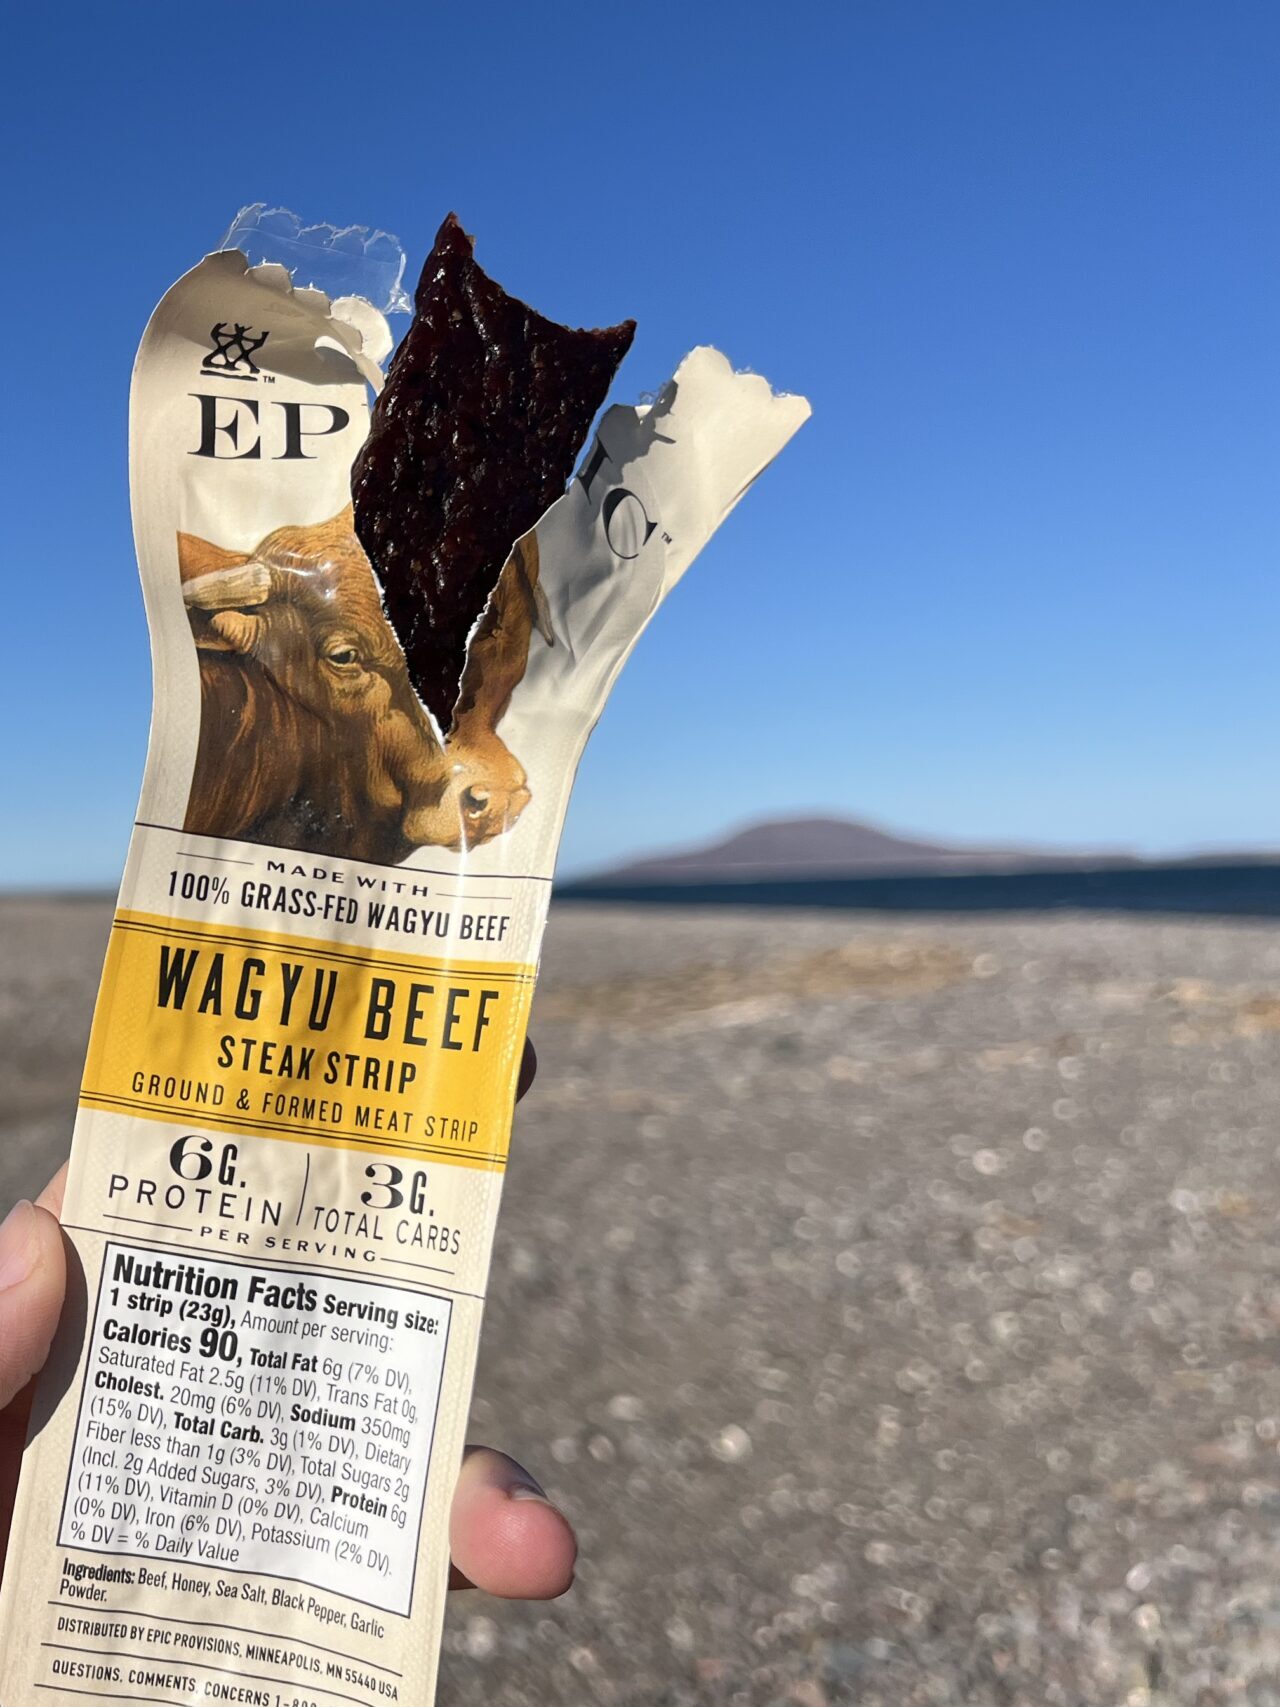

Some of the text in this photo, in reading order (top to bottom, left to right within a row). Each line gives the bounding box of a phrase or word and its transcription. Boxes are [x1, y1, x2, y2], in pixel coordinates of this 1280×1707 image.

[169, 870, 510, 941] 100% GRASS-FED WAGYU BEEF
[267, 861, 428, 897] MADE WITH
[157, 945, 499, 1052] WAGYU BEEF
[218, 1035, 416, 1094] STEAK STRIP
[132, 1072, 478, 1142] GROUND & FORMED MEAT STRIP
[109, 1174, 282, 1226] PROTEIN
[314, 1206, 460, 1254] TOTAL CARBS
[200, 1226, 375, 1262] PER SERVING
[110, 1288, 392, 1353] 1 strip (23g), Amount per serving:
[113, 1254, 438, 1335] Nutrition Facts Serving size:
[99, 1346, 175, 1376] Saturated
[180, 1361, 204, 1383] Fat
[208, 1367, 244, 1394] 2.5g
[250, 1374, 286, 1396] (11%
[327, 1383, 368, 1408] Trans
[375, 1393, 398, 1414] Fat
[103, 1319, 192, 1354] Calories
[199, 1328, 242, 1368] 90,
[250, 1348, 288, 1369] Total
[291, 1353, 318, 1372] Fat
[323, 1358, 342, 1381] 6g
[348, 1363, 378, 1384] (7%
[91, 1396, 131, 1419] (15%
[174, 1411, 215, 1436] Total
[220, 1420, 264, 1444] Carb.
[270, 1428, 288, 1450] 3g
[293, 1430, 322, 1451] (1%
[366, 1442, 410, 1475] Dietary
[95, 1370, 164, 1400] Cholest.
[170, 1386, 215, 1414] 20mg
[221, 1395, 252, 1416] (6%
[290, 1404, 356, 1431] Sodium
[362, 1417, 410, 1448] 350mg
[82, 1446, 118, 1468] (Incl.
[124, 1452, 143, 1475] 2g
[146, 1458, 197, 1482] Added
[201, 1466, 258, 1494] Sugars,
[265, 1478, 290, 1496] 3%
[331, 1486, 387, 1518] Protein
[391, 1504, 406, 1528] 6g
[86, 1420, 126, 1444] Fiber
[130, 1428, 161, 1450] less
[167, 1436, 200, 1458] than
[208, 1444, 225, 1465] 1g
[230, 1447, 260, 1467] (3%
[301, 1456, 336, 1477] Total
[342, 1463, 390, 1492] Sugars
[394, 1478, 409, 1502] 2g
[74, 1496, 105, 1518] (0%
[146, 1507, 175, 1528] Iron
[180, 1514, 209, 1535] (6%
[251, 1522, 330, 1552] Potassium
[335, 1541, 361, 1564] (2%
[78, 1471, 119, 1494] (11%
[160, 1485, 216, 1509] Vitamin
[222, 1493, 233, 1510] D
[238, 1496, 268, 1516] (0%
[310, 1507, 368, 1538] Calcium
[92, 1525, 114, 1544] DV
[155, 1534, 193, 1557] Daily
[198, 1539, 239, 1562] Value
[60, 1578, 107, 1602] Powder.
[62, 1558, 384, 1638] Ingredients: Beef, Honey, Sea Salt, Black Pepper, Garlic
[58, 1617, 127, 1638] DISTRIBUTED
[130, 1626, 145, 1640] BY
[147, 1628, 172, 1644] EPIC
[326, 1662, 342, 1679] MN
[346, 1668, 376, 1691] 55440
[379, 1681, 398, 1700] USA
[205, 1682, 270, 1707] CONCERNS
